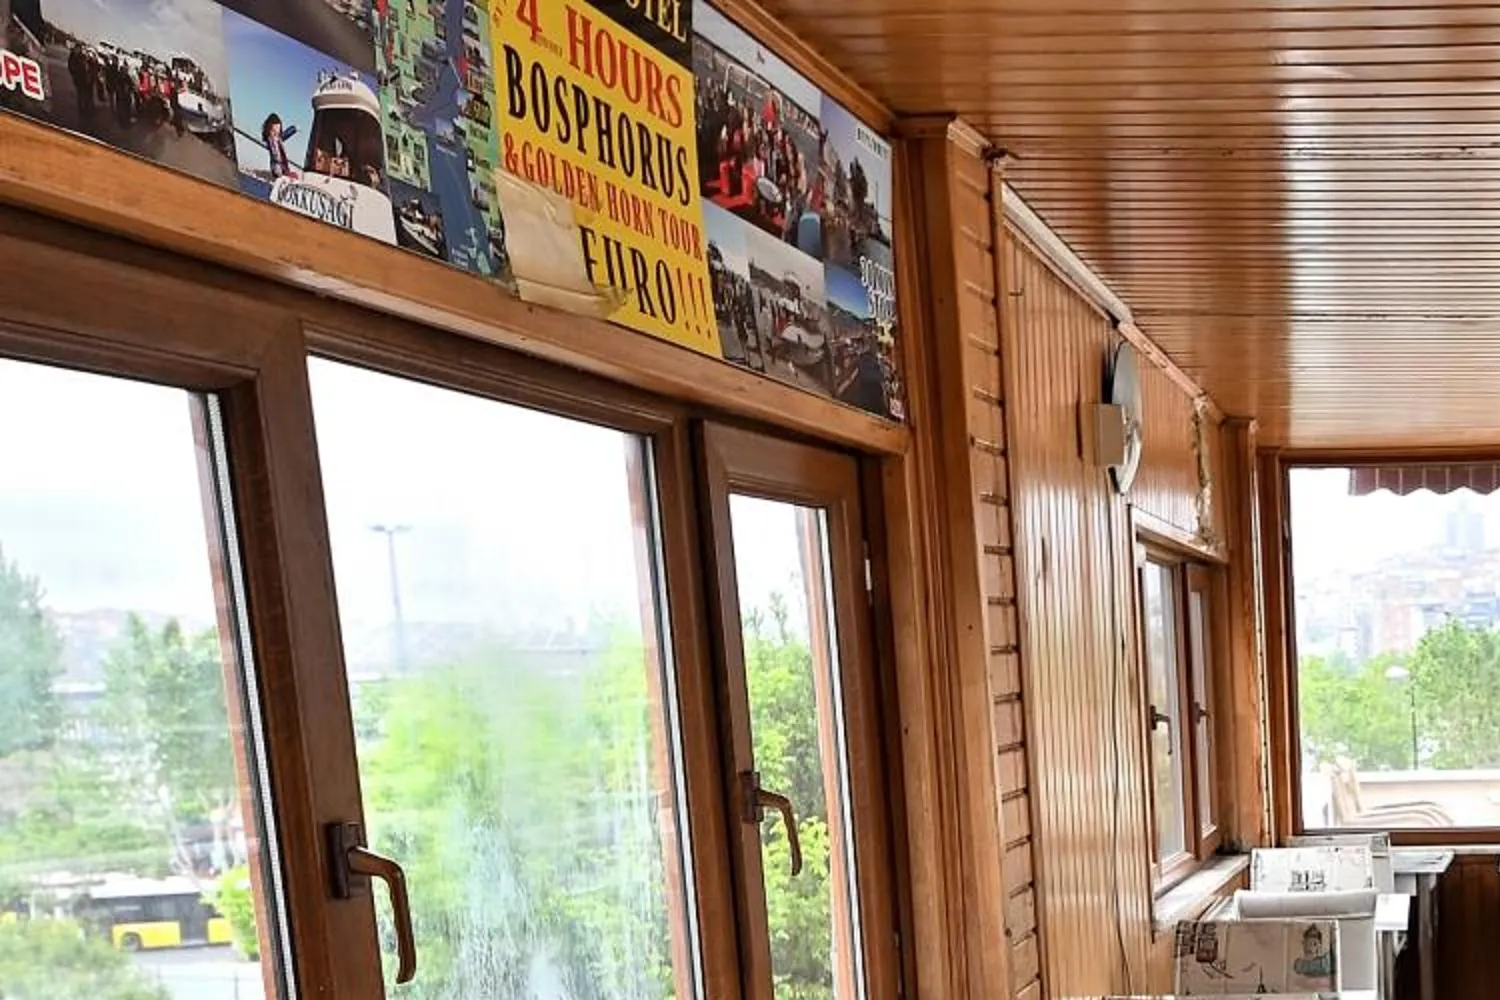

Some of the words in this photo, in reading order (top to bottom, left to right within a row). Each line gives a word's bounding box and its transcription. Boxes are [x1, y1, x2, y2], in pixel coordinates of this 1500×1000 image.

[0, 52, 42, 97] PE
[515, 0, 543, 42] 4
[565, 4, 683, 129] HOURS
[503, 43, 691, 206] BOSPHORUS
[605, 180, 656, 240] HORN
[657, 207, 704, 262] TOUR
